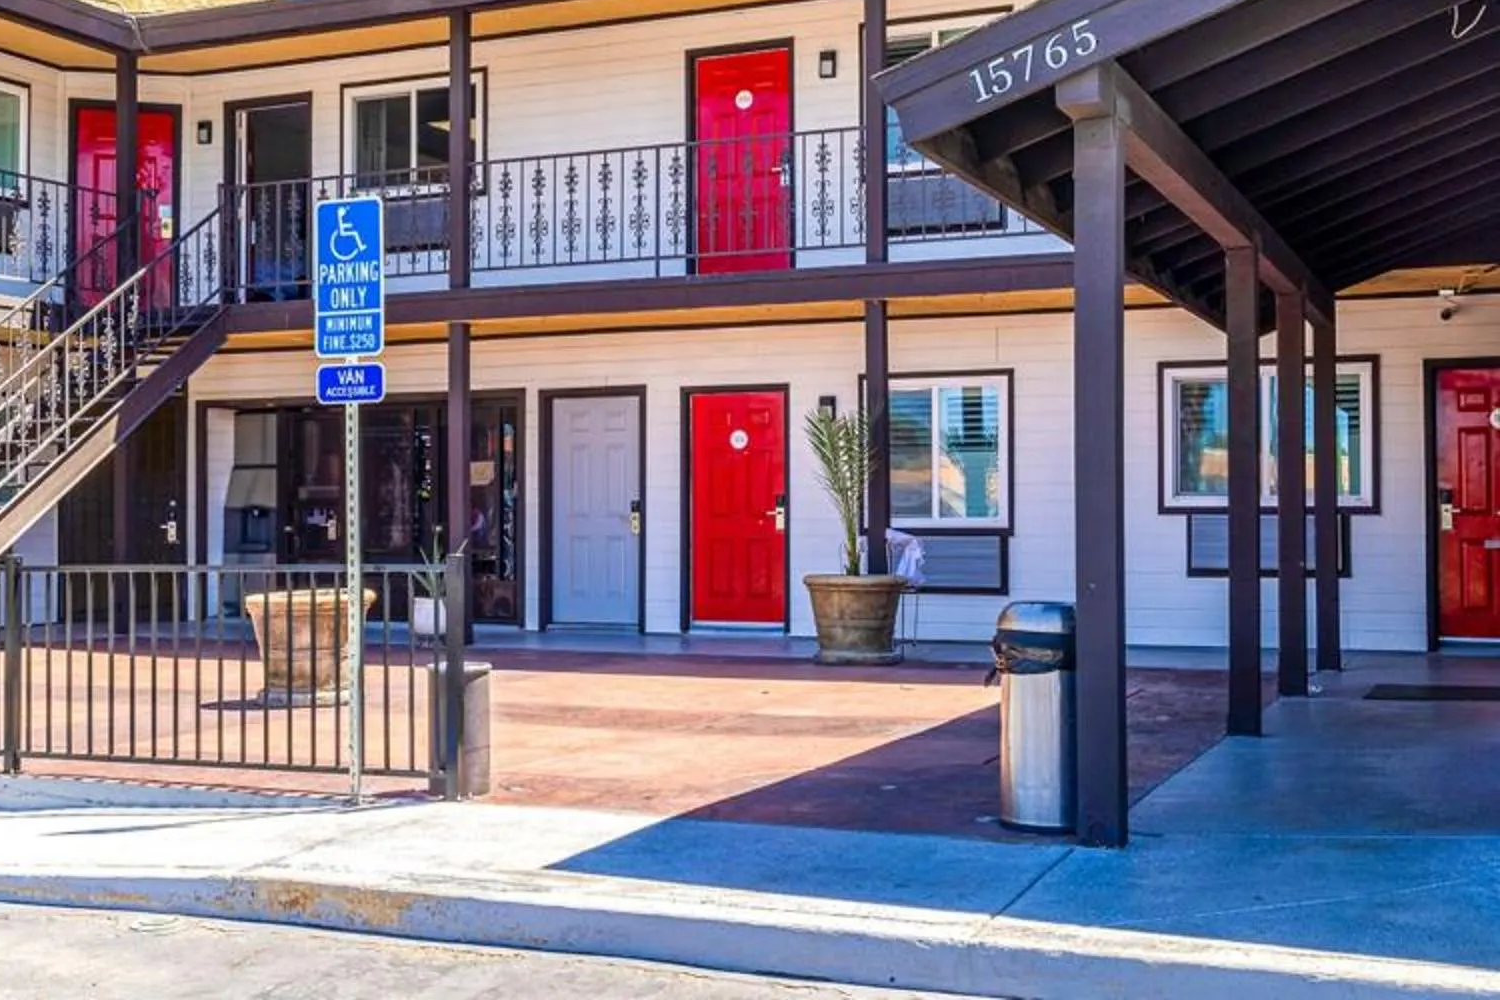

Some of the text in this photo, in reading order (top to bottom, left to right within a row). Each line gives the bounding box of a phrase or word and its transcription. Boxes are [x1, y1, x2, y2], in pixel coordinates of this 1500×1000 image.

[969, 19, 1097, 103] 15765
[319, 261, 379, 285] PARKING
[331, 286, 367, 309] ONLY
[326, 315, 373, 333] MINIMUM
[337, 368, 365, 385] VAN
